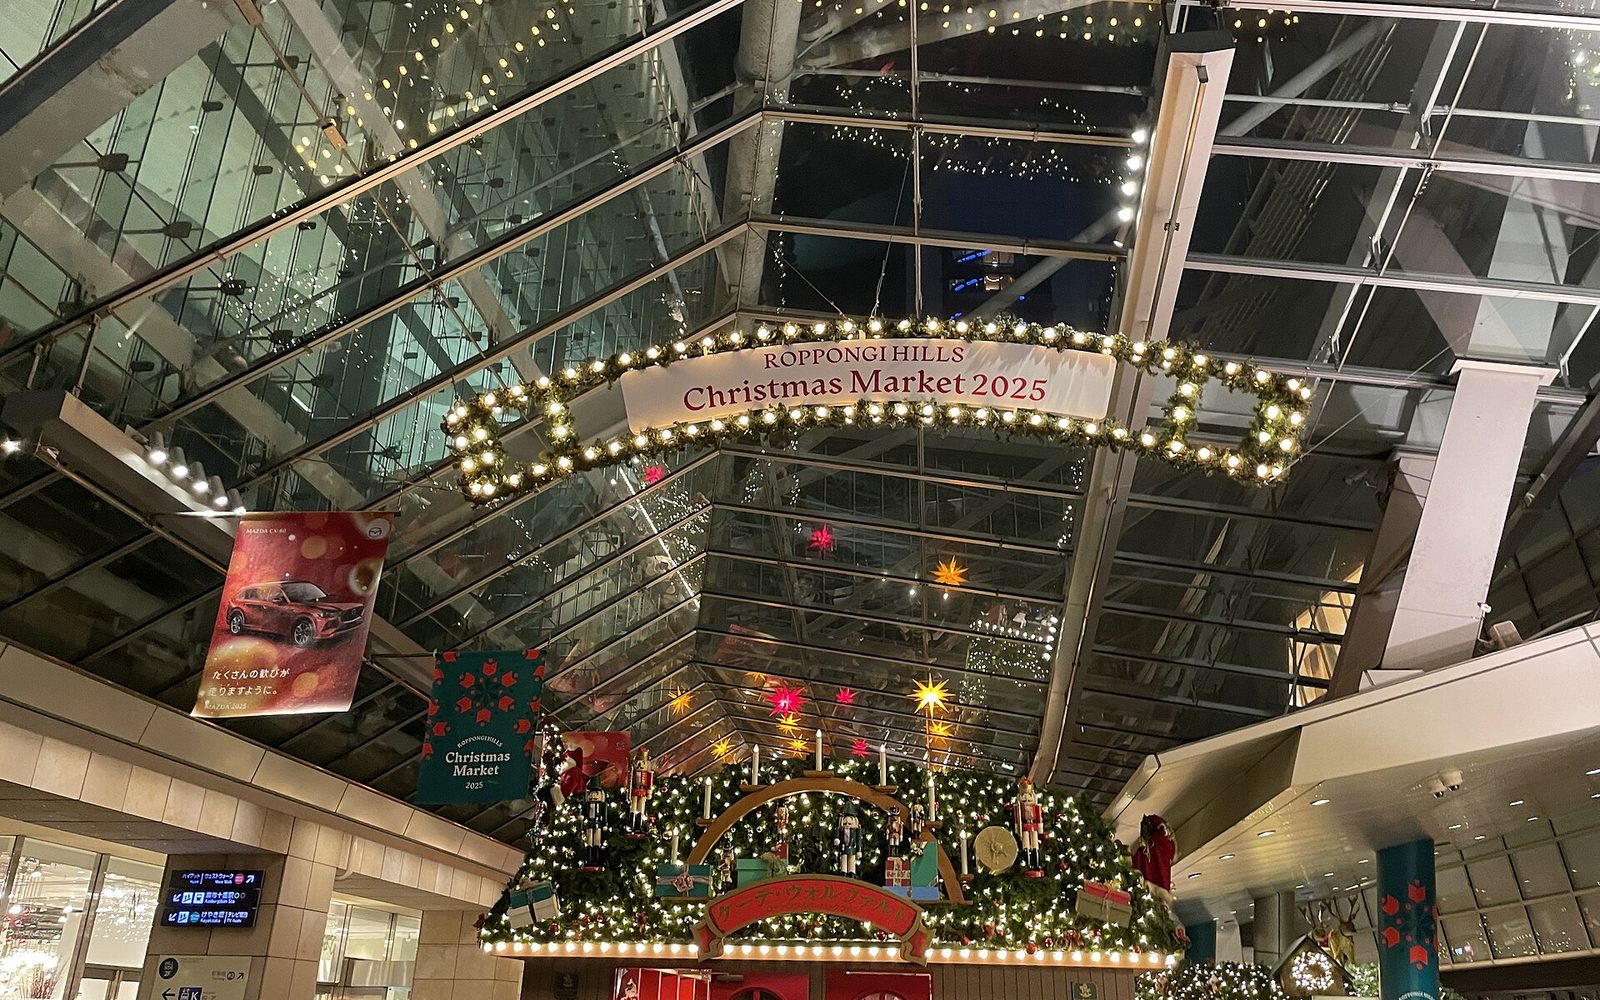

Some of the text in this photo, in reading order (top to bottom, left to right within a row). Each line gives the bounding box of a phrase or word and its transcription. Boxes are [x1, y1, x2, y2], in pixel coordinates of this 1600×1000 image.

[764, 345, 965, 369] ROPPONGI HILLS
[683, 369, 1049, 411] Christmas Market 2025
[212, 668, 290, 680] たくさんの歓びが
[445, 751, 511, 764] Christmas
[453, 764, 500, 777] Market
[465, 781, 484, 790] 2025
